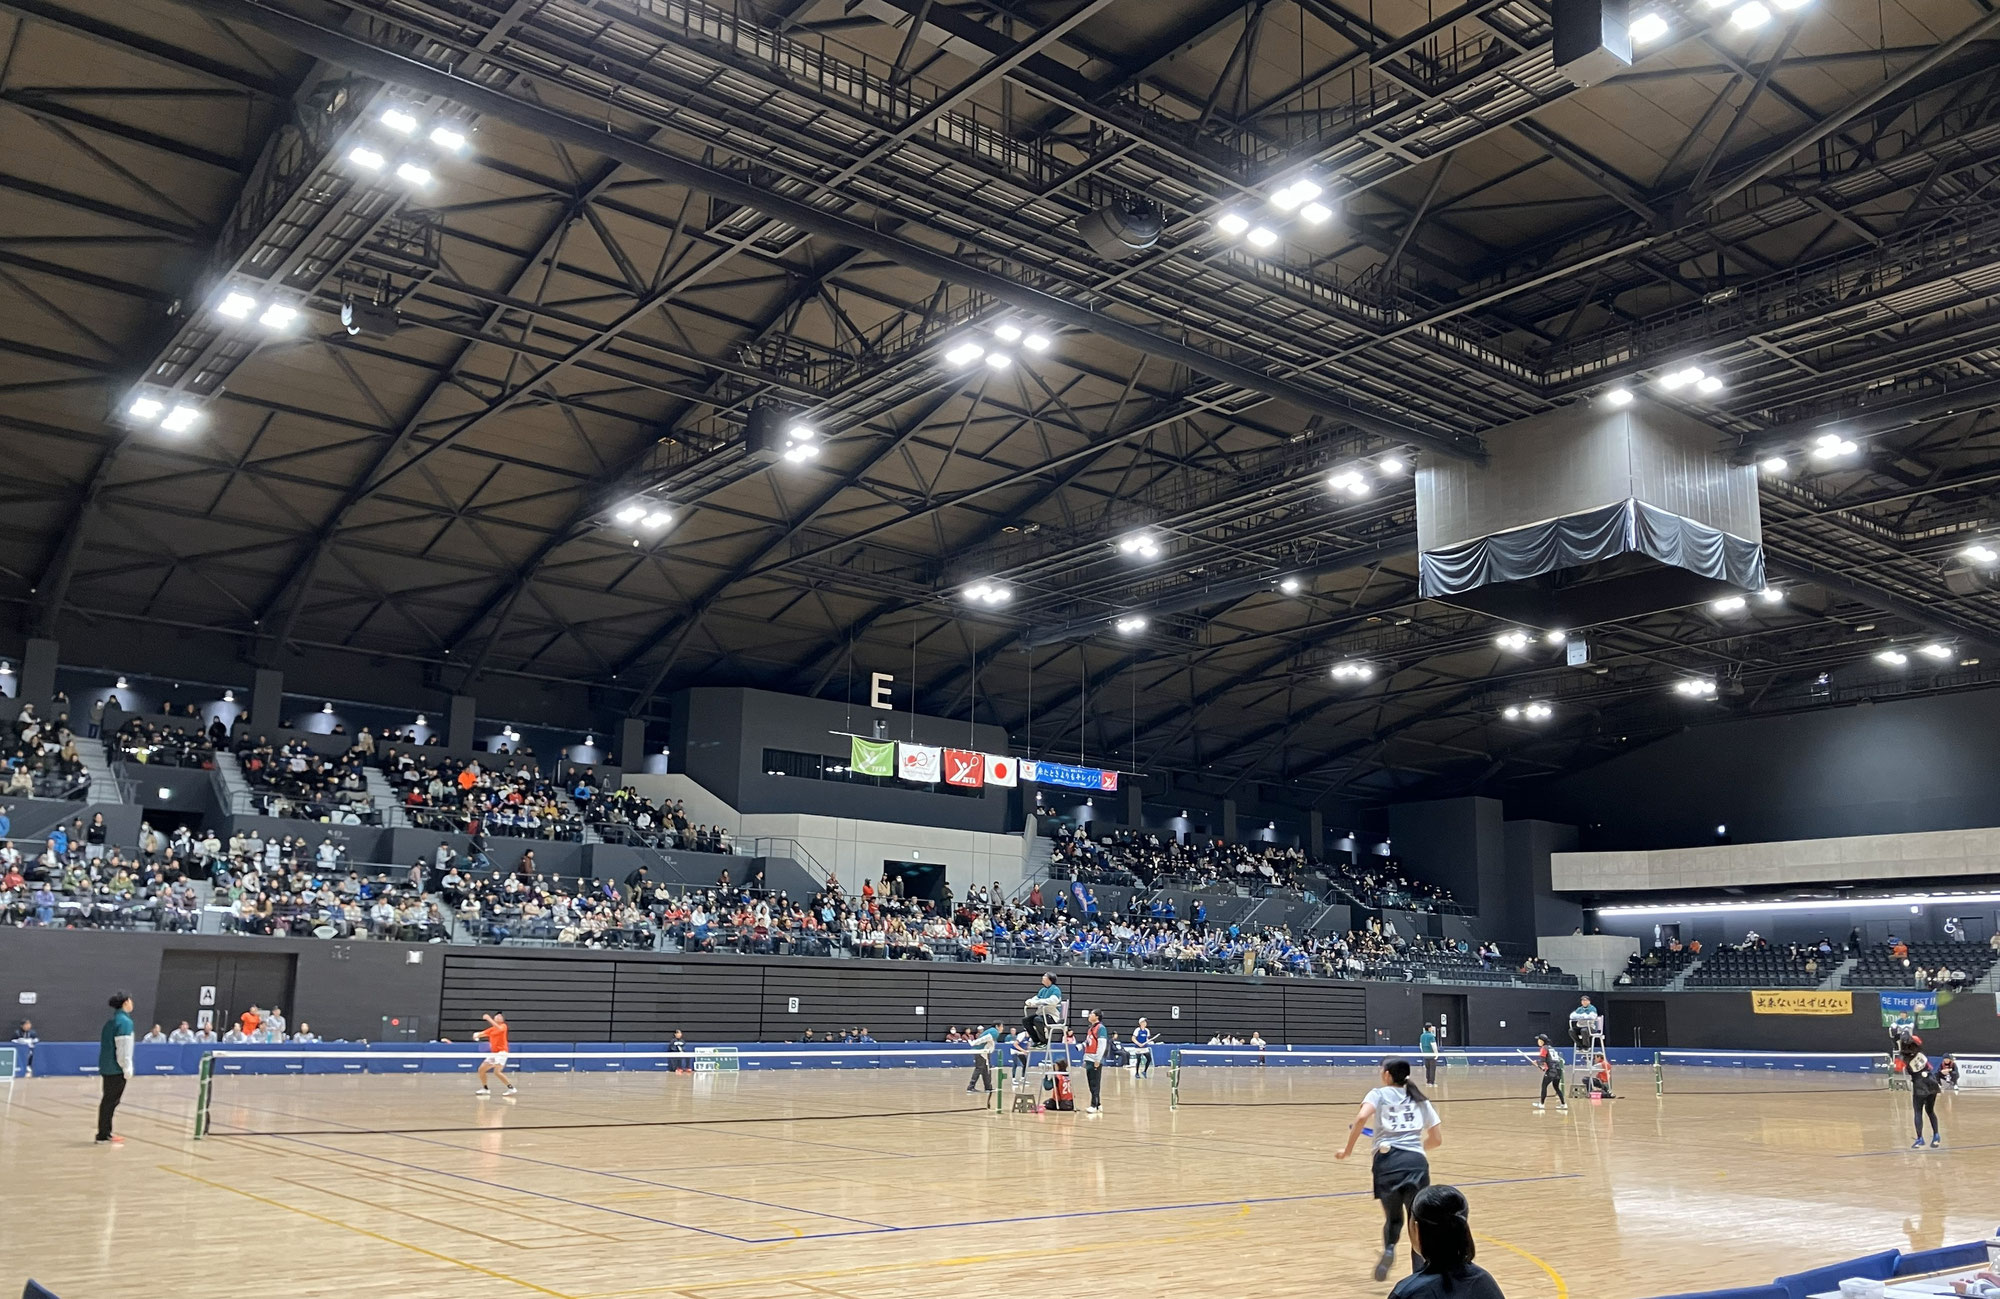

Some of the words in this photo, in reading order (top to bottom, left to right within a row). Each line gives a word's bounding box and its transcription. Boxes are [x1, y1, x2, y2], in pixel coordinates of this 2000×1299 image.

[871, 672, 893, 710] E
[203, 989, 212, 999] A
[1881, 997, 1892, 1005] BE
[1893, 997, 1908, 1006] THE
[1910, 997, 1930, 1006] BEST
